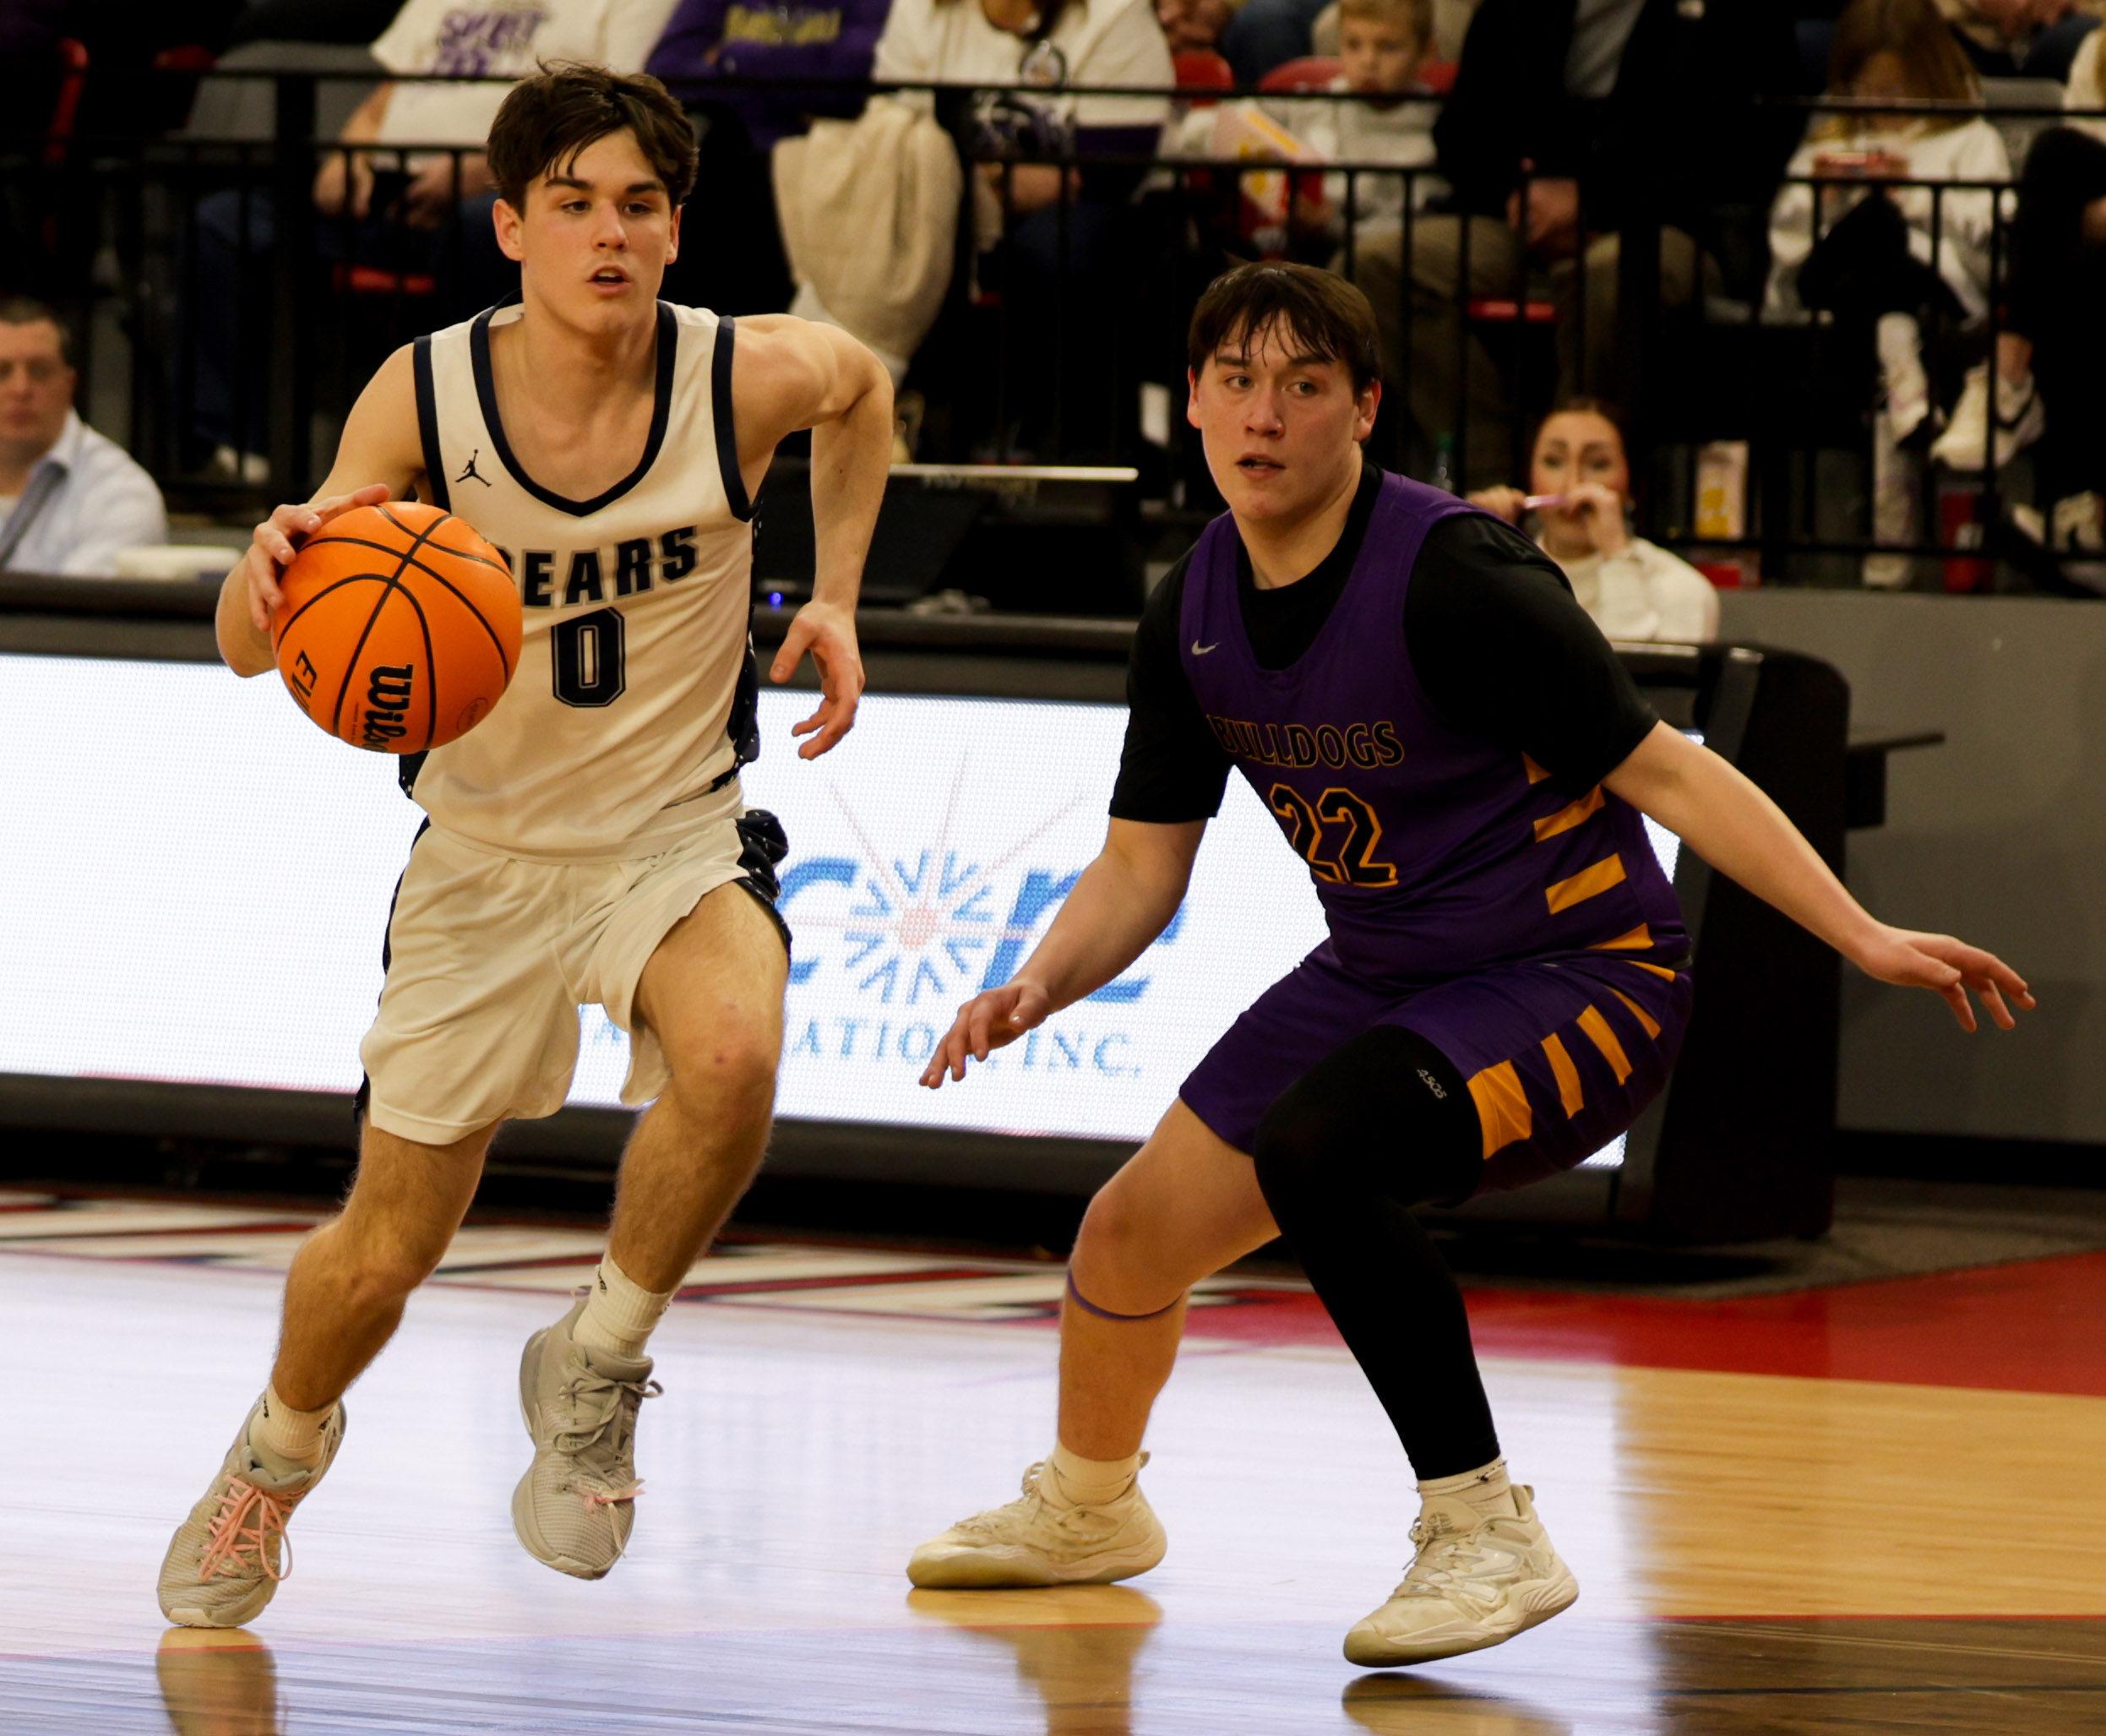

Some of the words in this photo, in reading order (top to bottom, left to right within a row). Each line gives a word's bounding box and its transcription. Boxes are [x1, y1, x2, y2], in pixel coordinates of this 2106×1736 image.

[495, 525, 699, 608] EARS
[291, 649, 318, 713] EV
[550, 606, 627, 709] 0
[361, 662, 415, 753] Wilso
[1269, 782, 1399, 888] 22
[1022, 1029, 1142, 1078] INC.
